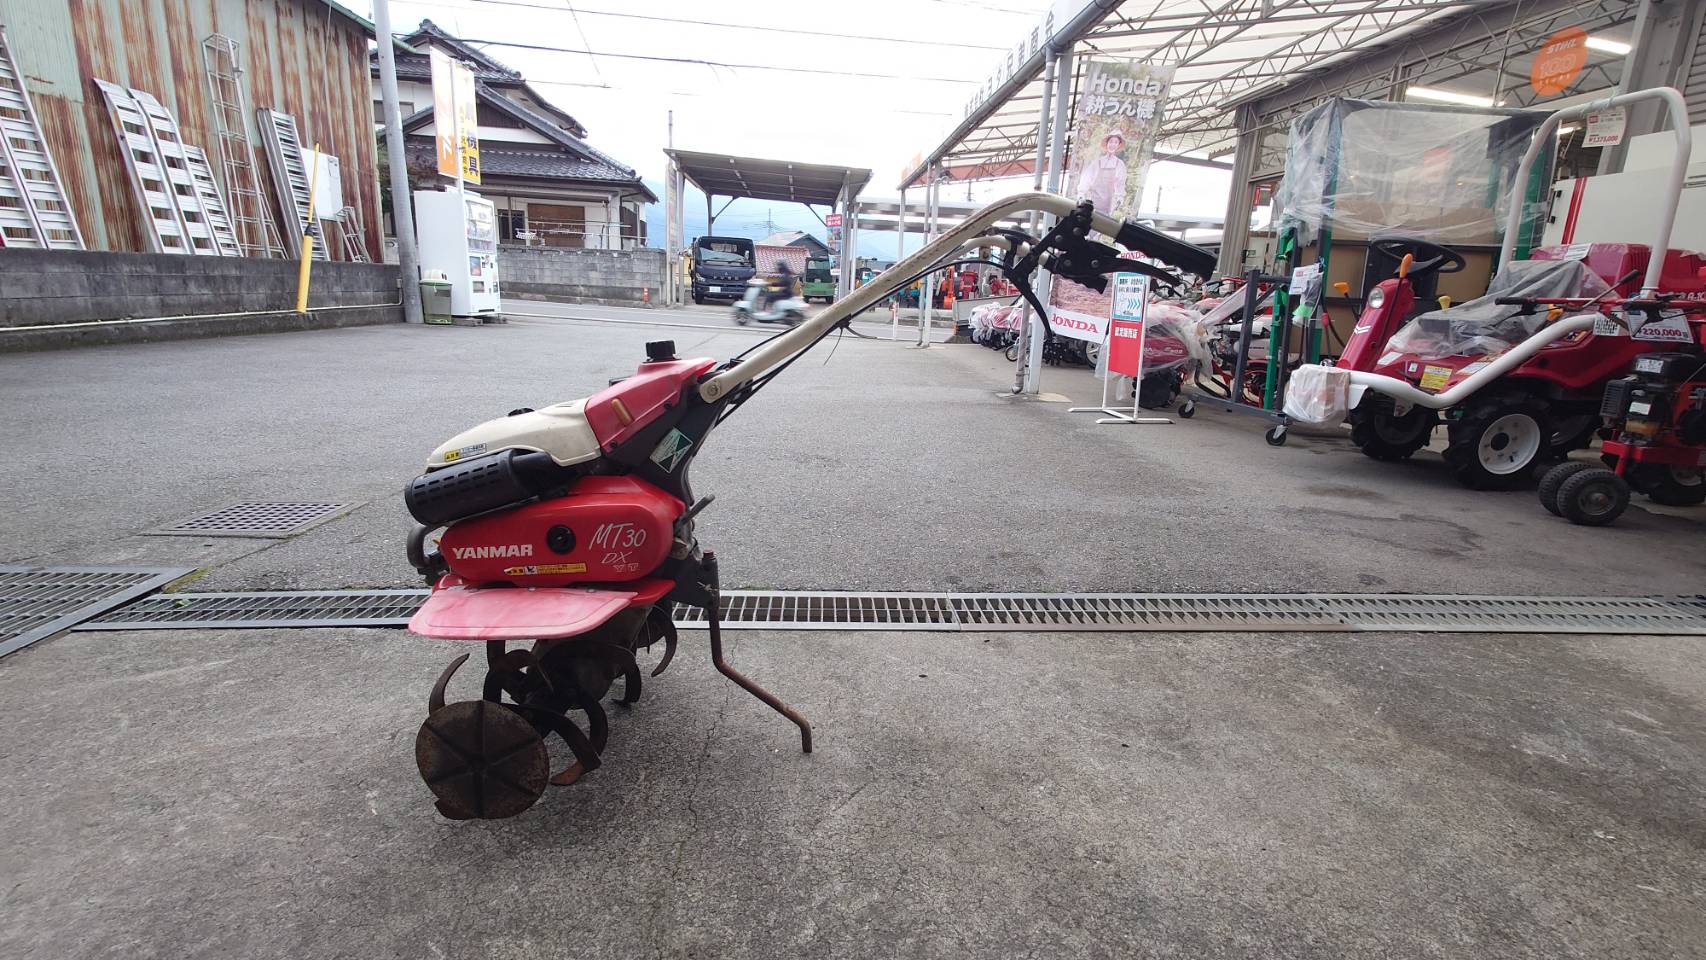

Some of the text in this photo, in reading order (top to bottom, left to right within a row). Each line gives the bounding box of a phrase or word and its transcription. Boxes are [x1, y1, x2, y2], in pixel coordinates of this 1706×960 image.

[1546, 39, 1576, 54] STIHL
[1091, 73, 1161, 96] Honda
[1085, 95, 1156, 120] 耕うん機
[589, 523, 647, 550] MT30
[453, 544, 533, 559] YANMAR
[601, 551, 633, 564] DX
